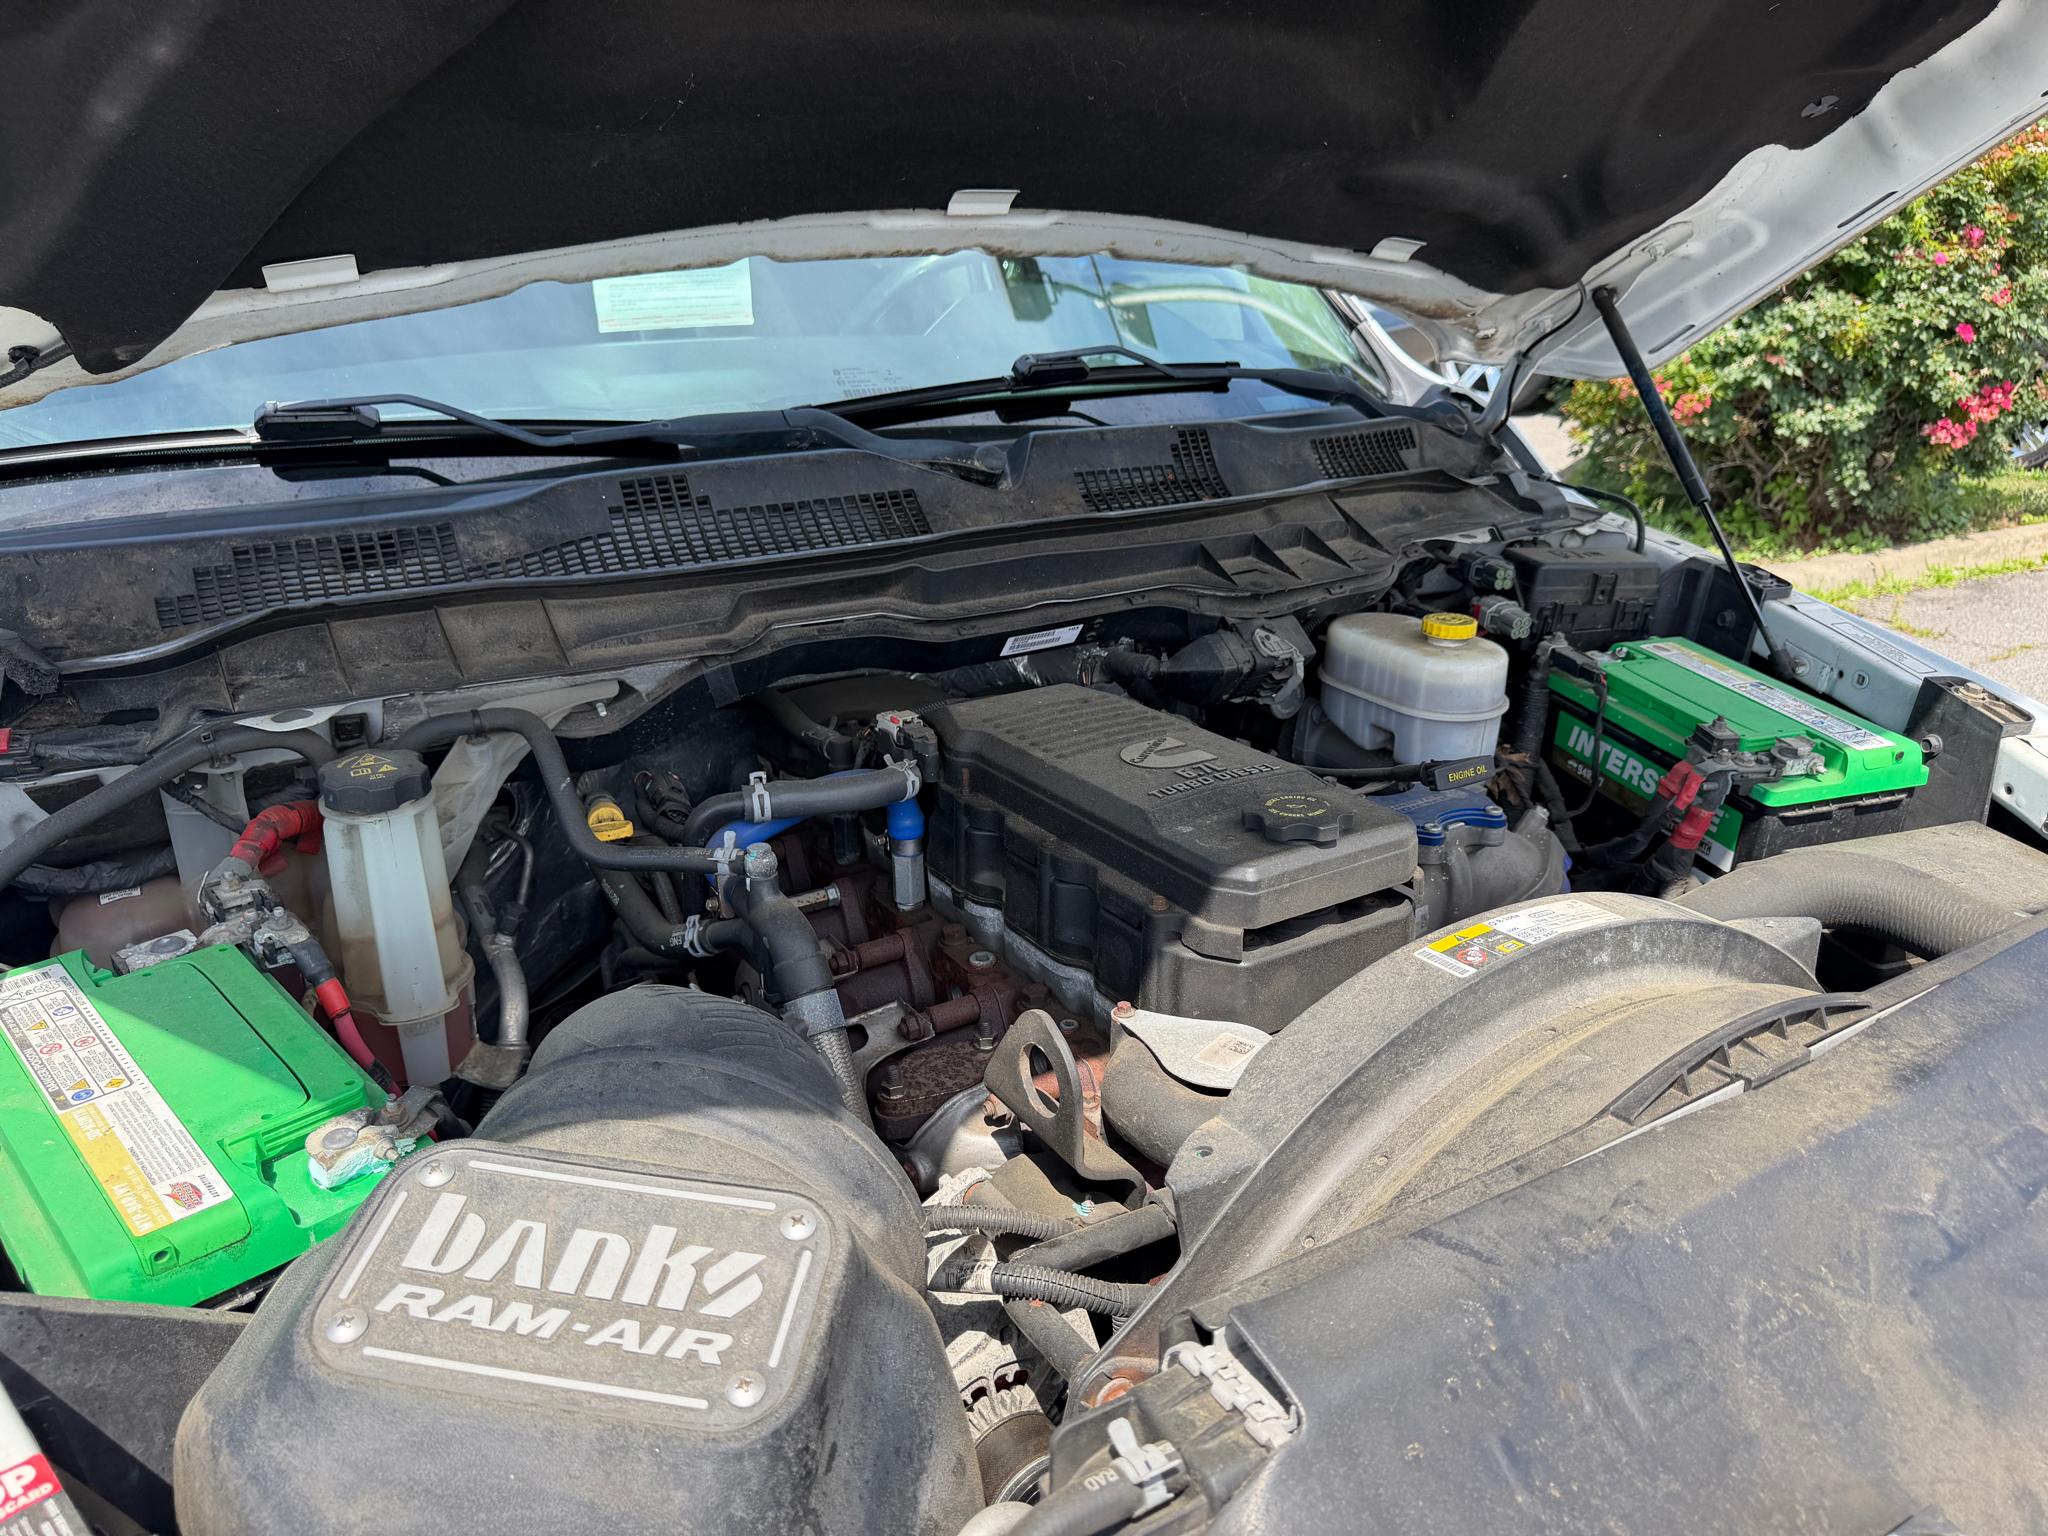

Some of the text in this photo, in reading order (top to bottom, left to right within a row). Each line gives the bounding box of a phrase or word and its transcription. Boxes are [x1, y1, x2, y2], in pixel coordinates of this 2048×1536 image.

[1174, 762, 1228, 779] 6.7L
[1448, 765, 1488, 782] ENGINE OIL
[1147, 763, 1281, 799] TURBO DIESEL
[670, 935, 682, 947] ENG
[374, 1282, 735, 1366] RAM-AIR
[1084, 1468, 1120, 1491] RAD
